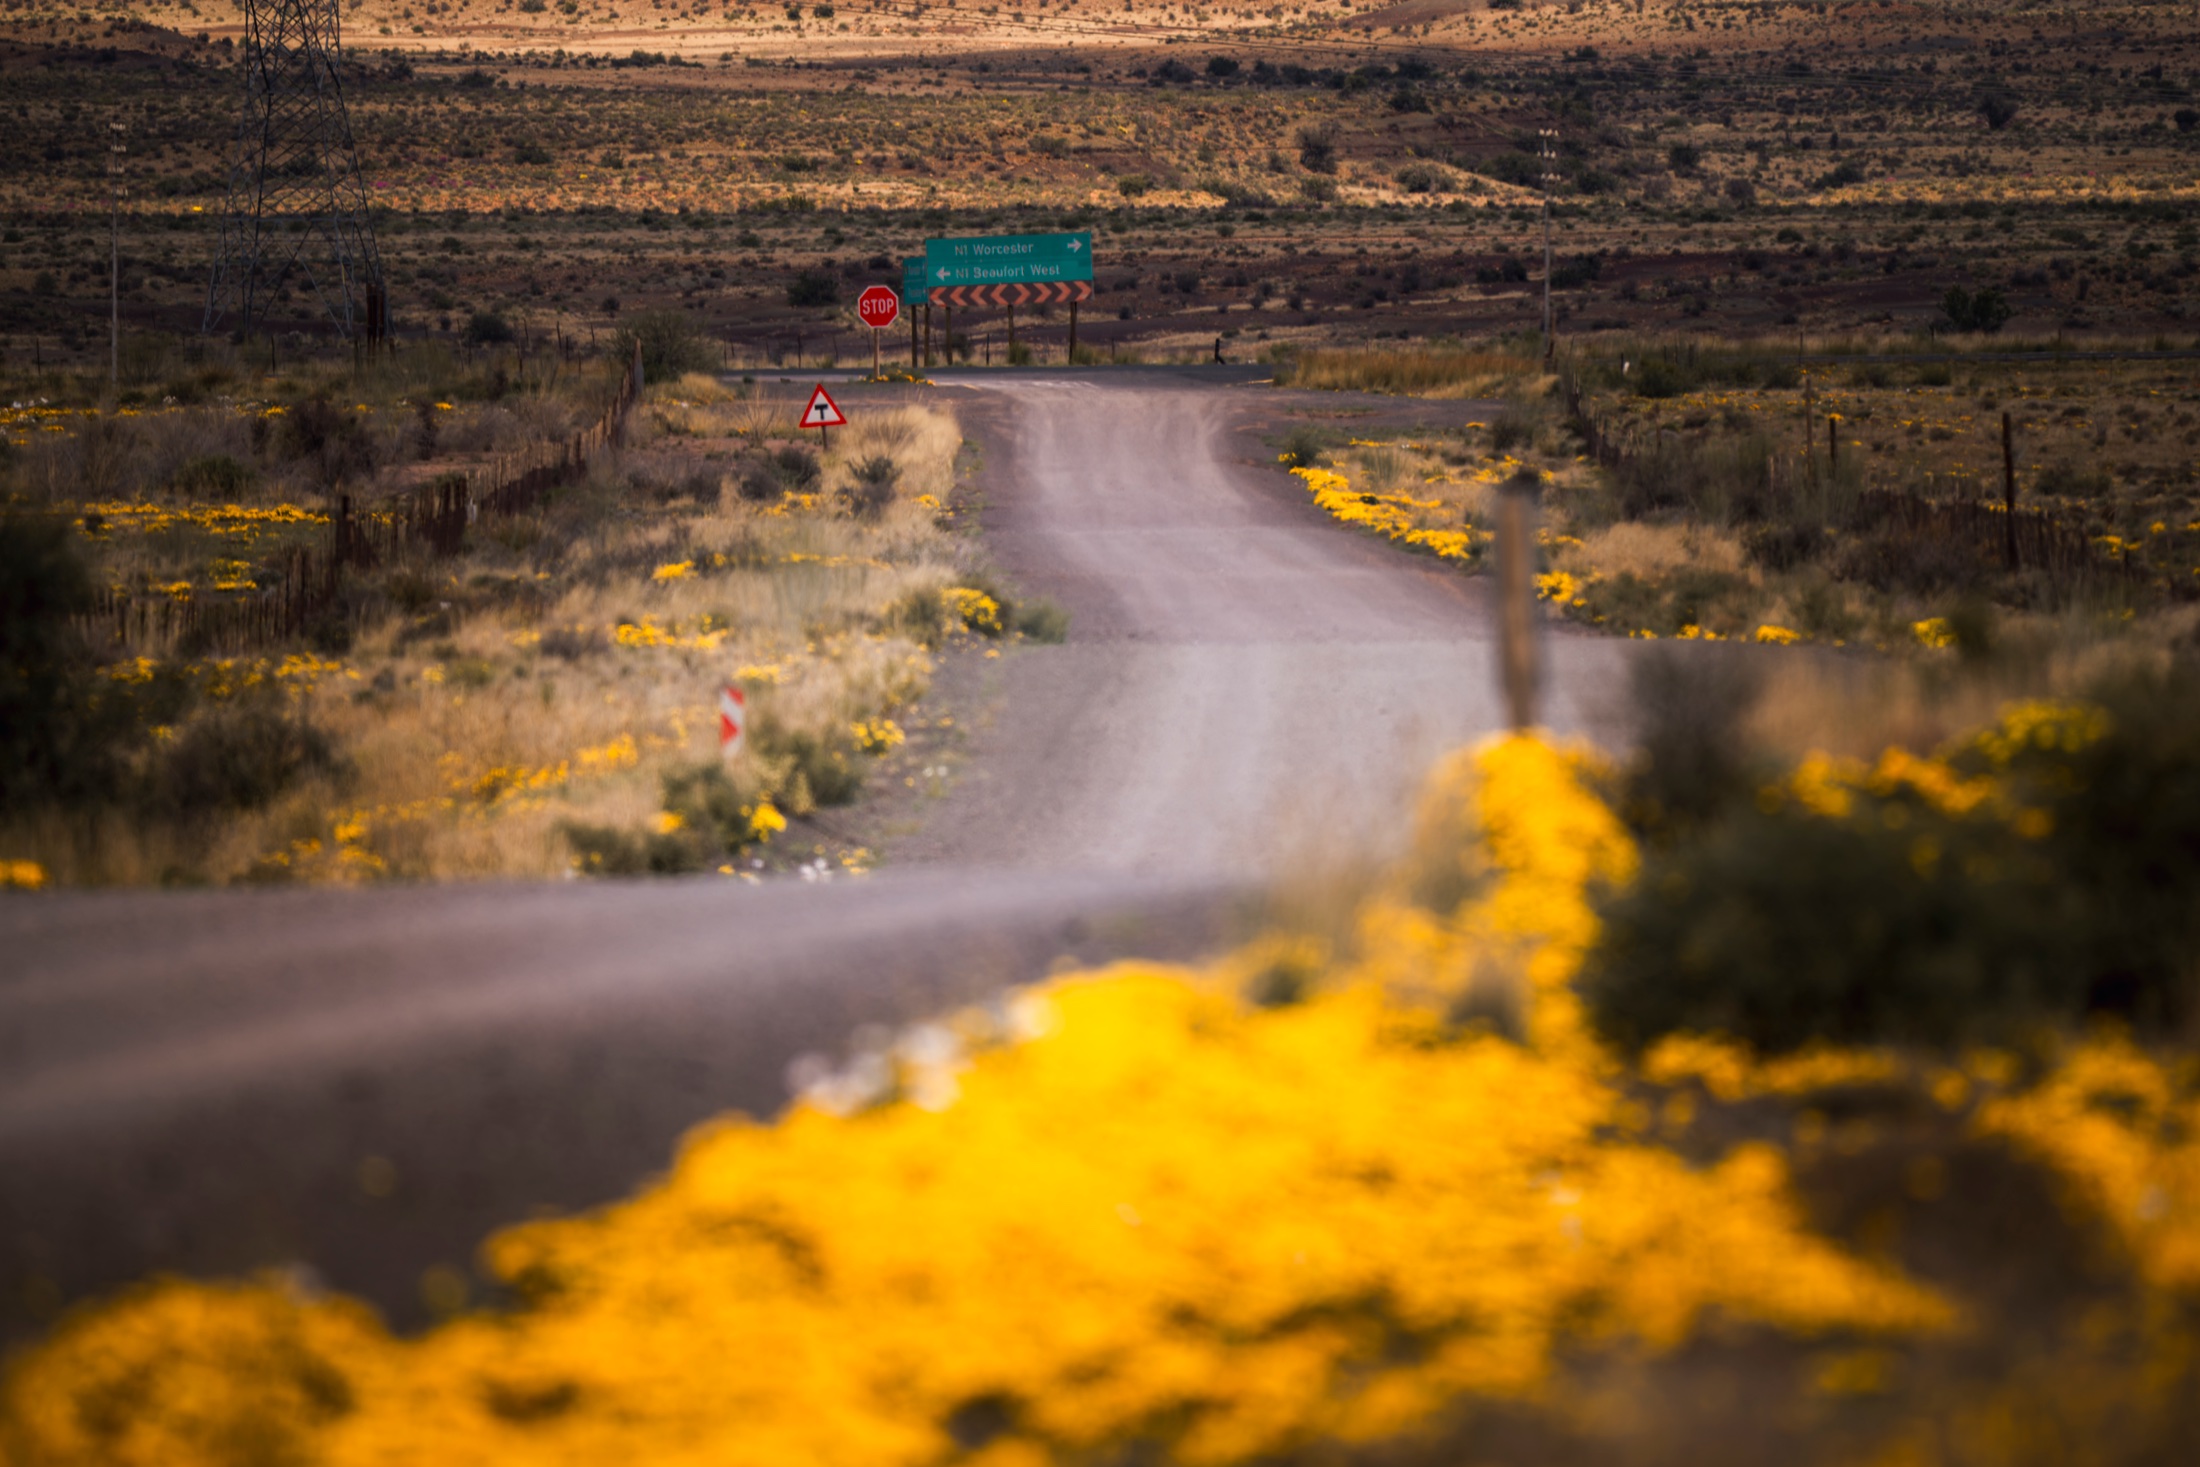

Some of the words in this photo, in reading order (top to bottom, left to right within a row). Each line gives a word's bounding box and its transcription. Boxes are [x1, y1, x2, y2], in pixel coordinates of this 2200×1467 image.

[954, 245, 968, 256] N1
[973, 243, 1034, 255] Worcester
[955, 267, 969, 279] N1
[973, 265, 1025, 278] Beaufort
[1030, 264, 1061, 275] West
[862, 298, 895, 315] STOP
